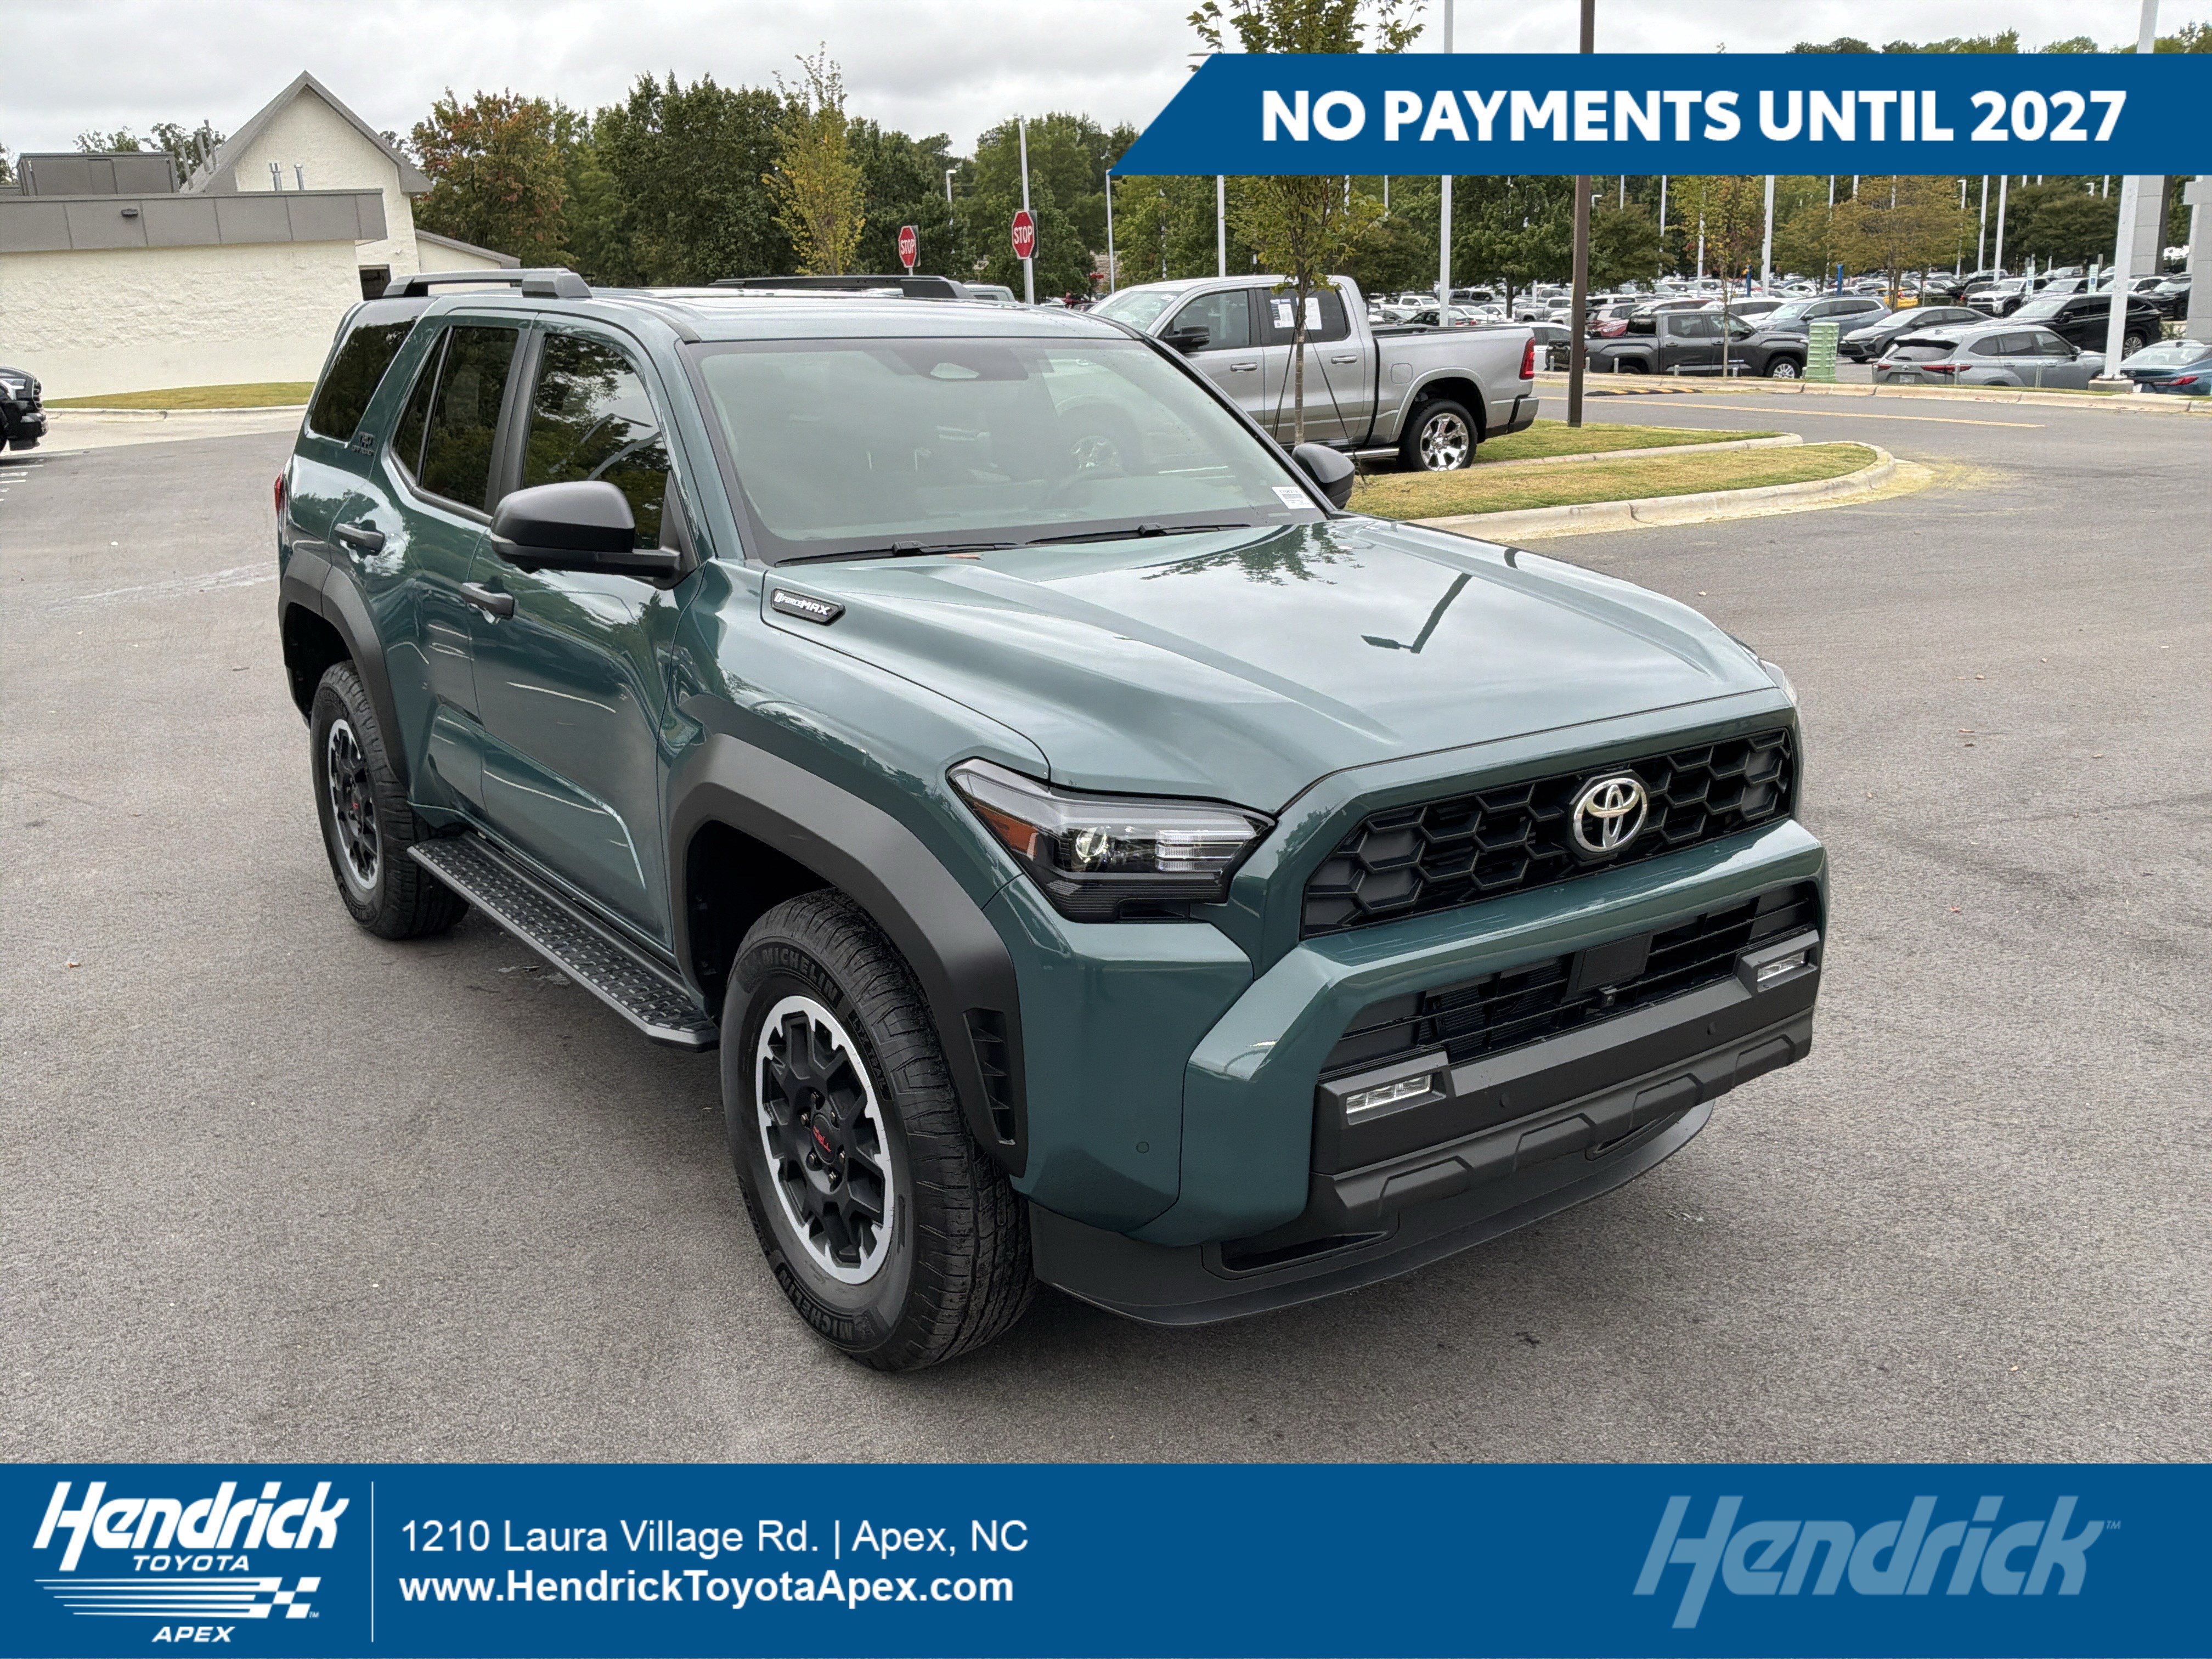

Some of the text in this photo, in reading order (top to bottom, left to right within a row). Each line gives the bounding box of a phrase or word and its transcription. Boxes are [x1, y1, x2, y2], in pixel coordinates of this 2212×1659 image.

[900, 239, 916, 255] STOP
[1013, 225, 1032, 245] STOP
[762, 947, 838, 1000] MICHELIN
[777, 1269, 854, 1341] MICHELIN
